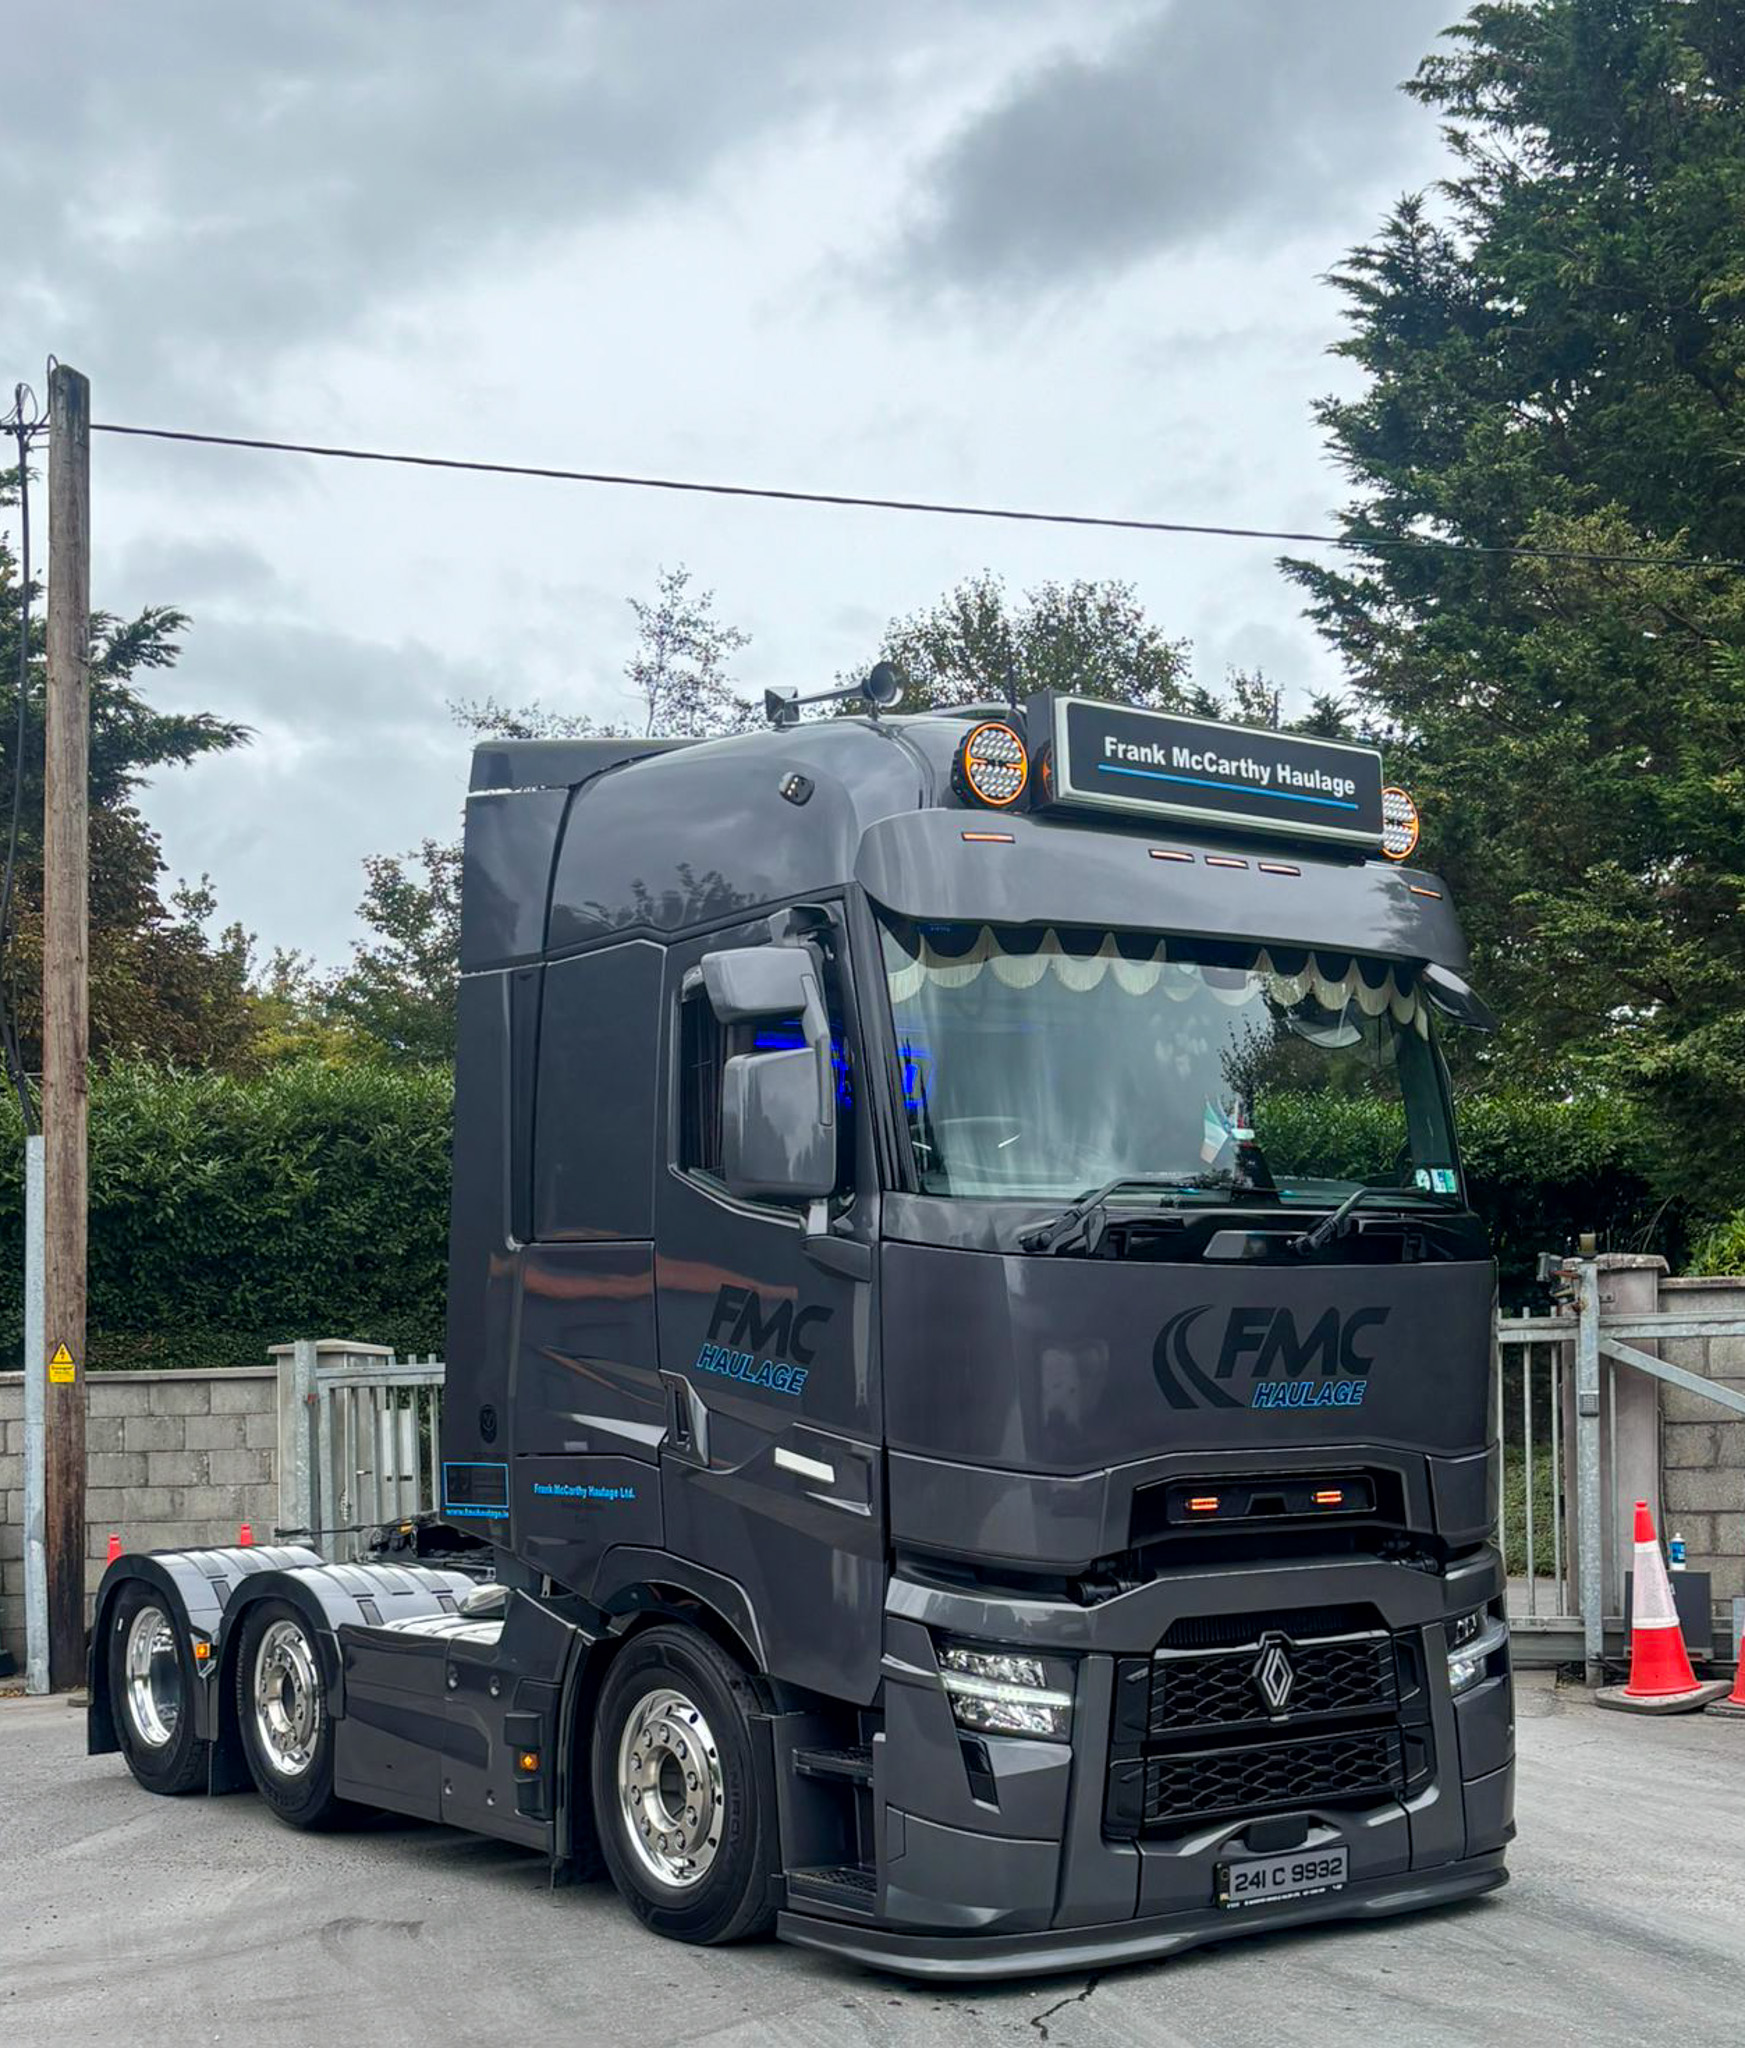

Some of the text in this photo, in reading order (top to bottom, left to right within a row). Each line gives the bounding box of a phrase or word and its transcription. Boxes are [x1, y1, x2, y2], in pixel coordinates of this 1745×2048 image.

[1104, 735, 1356, 798] Frank McCarthy Haulage
[706, 1283, 834, 1364] FMC
[1214, 1306, 1391, 1378] FMC
[696, 1342, 808, 1395] HAULAGE
[1251, 1380, 1367, 1408] HAULAGE
[534, 1483, 553, 1494] Frank
[553, 1484, 587, 1499] McCarthy
[588, 1486, 619, 1500] Haulage
[1235, 1857, 1342, 1892] 241 C 9932
